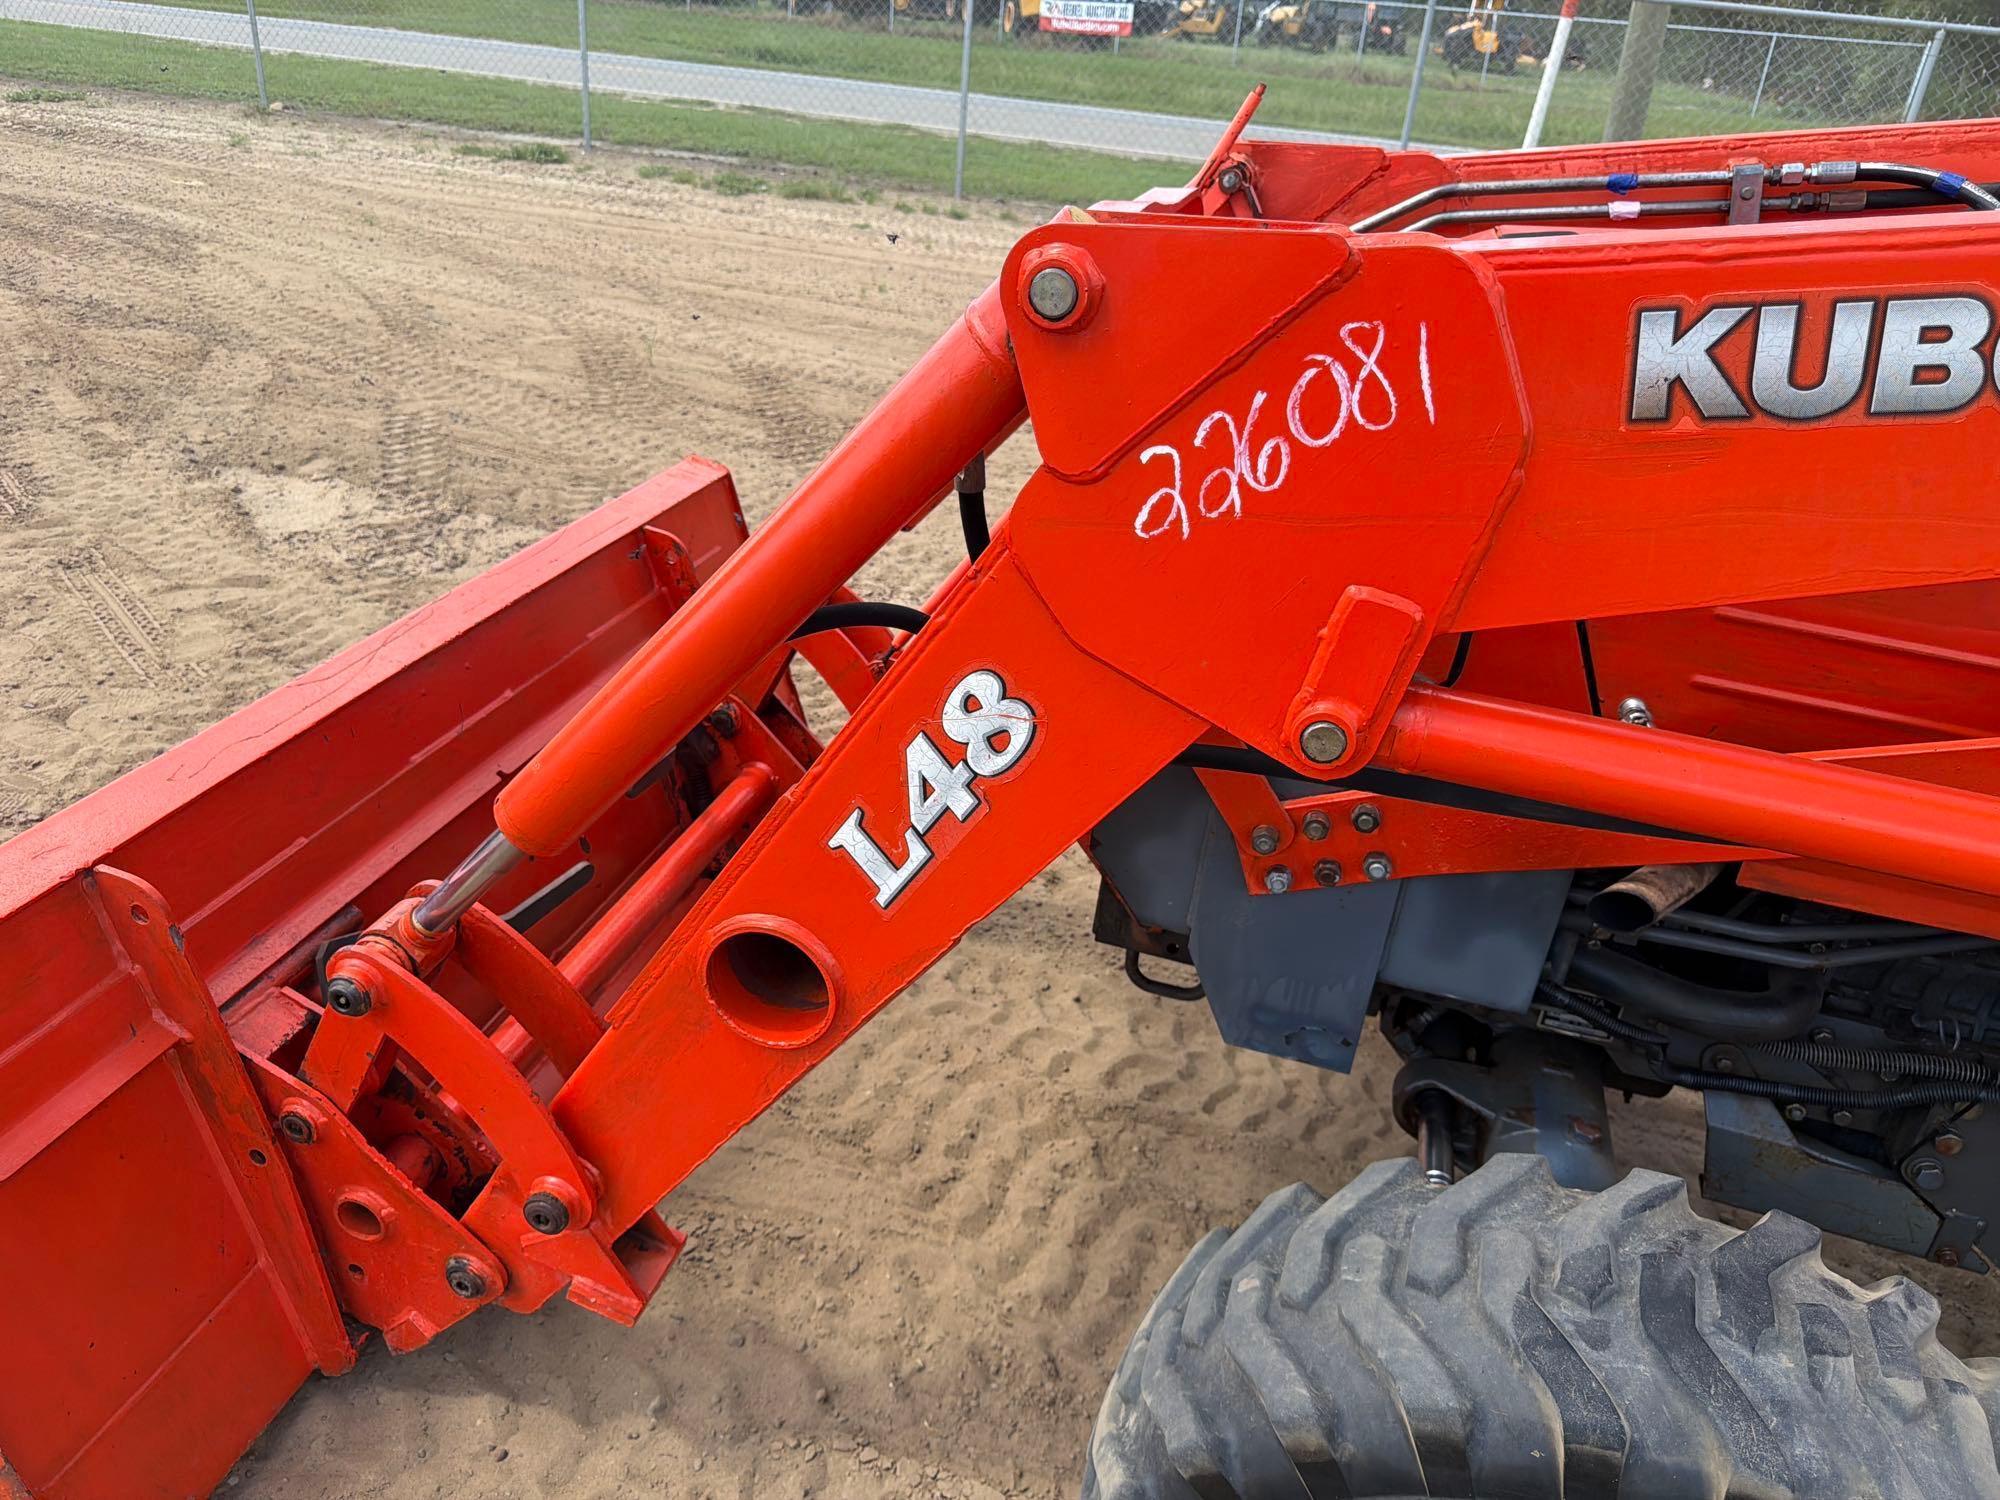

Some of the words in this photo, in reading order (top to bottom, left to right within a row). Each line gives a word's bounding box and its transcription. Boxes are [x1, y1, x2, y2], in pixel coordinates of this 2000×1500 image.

[1134, 320, 1436, 541] 226081
[1629, 295, 2000, 422] KUB
[827, 668, 1037, 910] L48
